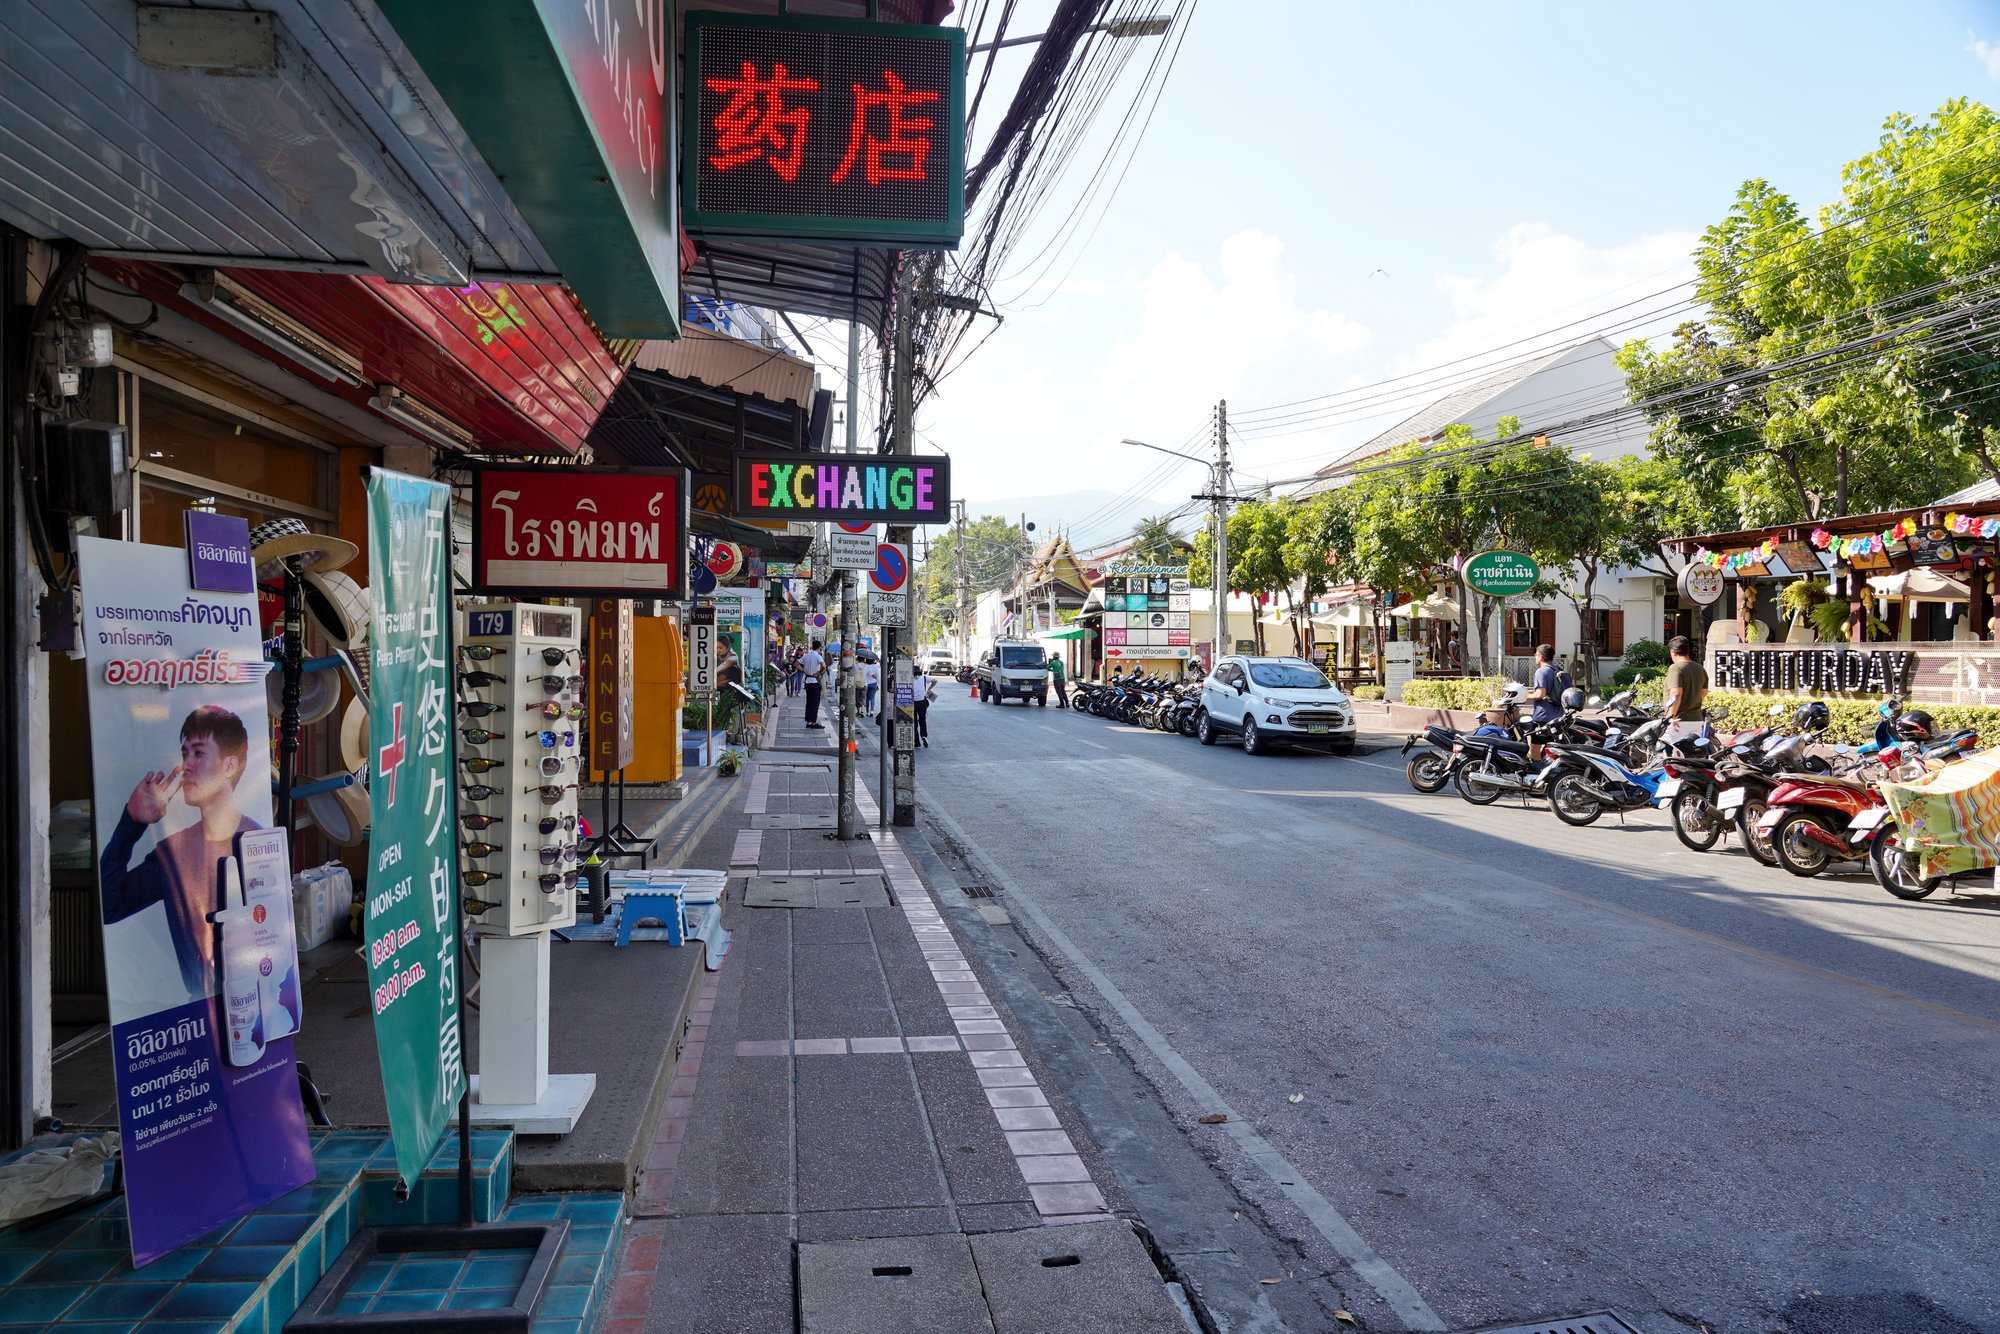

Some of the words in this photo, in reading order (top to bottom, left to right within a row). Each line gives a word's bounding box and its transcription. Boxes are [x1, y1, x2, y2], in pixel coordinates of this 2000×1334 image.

[706, 61, 939, 185] 药店
[751, 463, 934, 510] EXCHANGE
[491, 489, 664, 560] โรงพิมพ์
[854, 548, 875, 556] SUNDAY
[1109, 561, 1188, 575] Rachadamnoe
[1473, 563, 1534, 578] ราชดำเนิน
[98, 628, 172, 646] จากโรคหวัด
[478, 613, 503, 634] 179
[1105, 637, 1126, 645] ATM
[106, 648, 242, 690] ออกฤทธิ์เร็ว
[698, 627, 708, 685] DRUG
[1715, 650, 1911, 695] FRUITURDAY
[379, 842, 402, 873] OPEN
[370, 876, 413, 921] MON-SAT
[371, 929, 397, 970] 09.30
[398, 919, 421, 947] a.m.
[374, 974, 400, 1016] 08.00
[401, 960, 426, 998] p.m.
[126, 1017, 207, 1060] อิลิอาดิน
[128, 1056, 157, 1074] (0.05%
[130, 1058, 210, 1098] ออกฤทธิ์อยู่ได้
[132, 1102, 155, 1120] นาน
[157, 1094, 173, 1110] 12
[175, 1082, 210, 1104] ชั่วโมง
[197, 1108, 203, 1117] 2
[203, 1100, 218, 1114] ครั้ง
